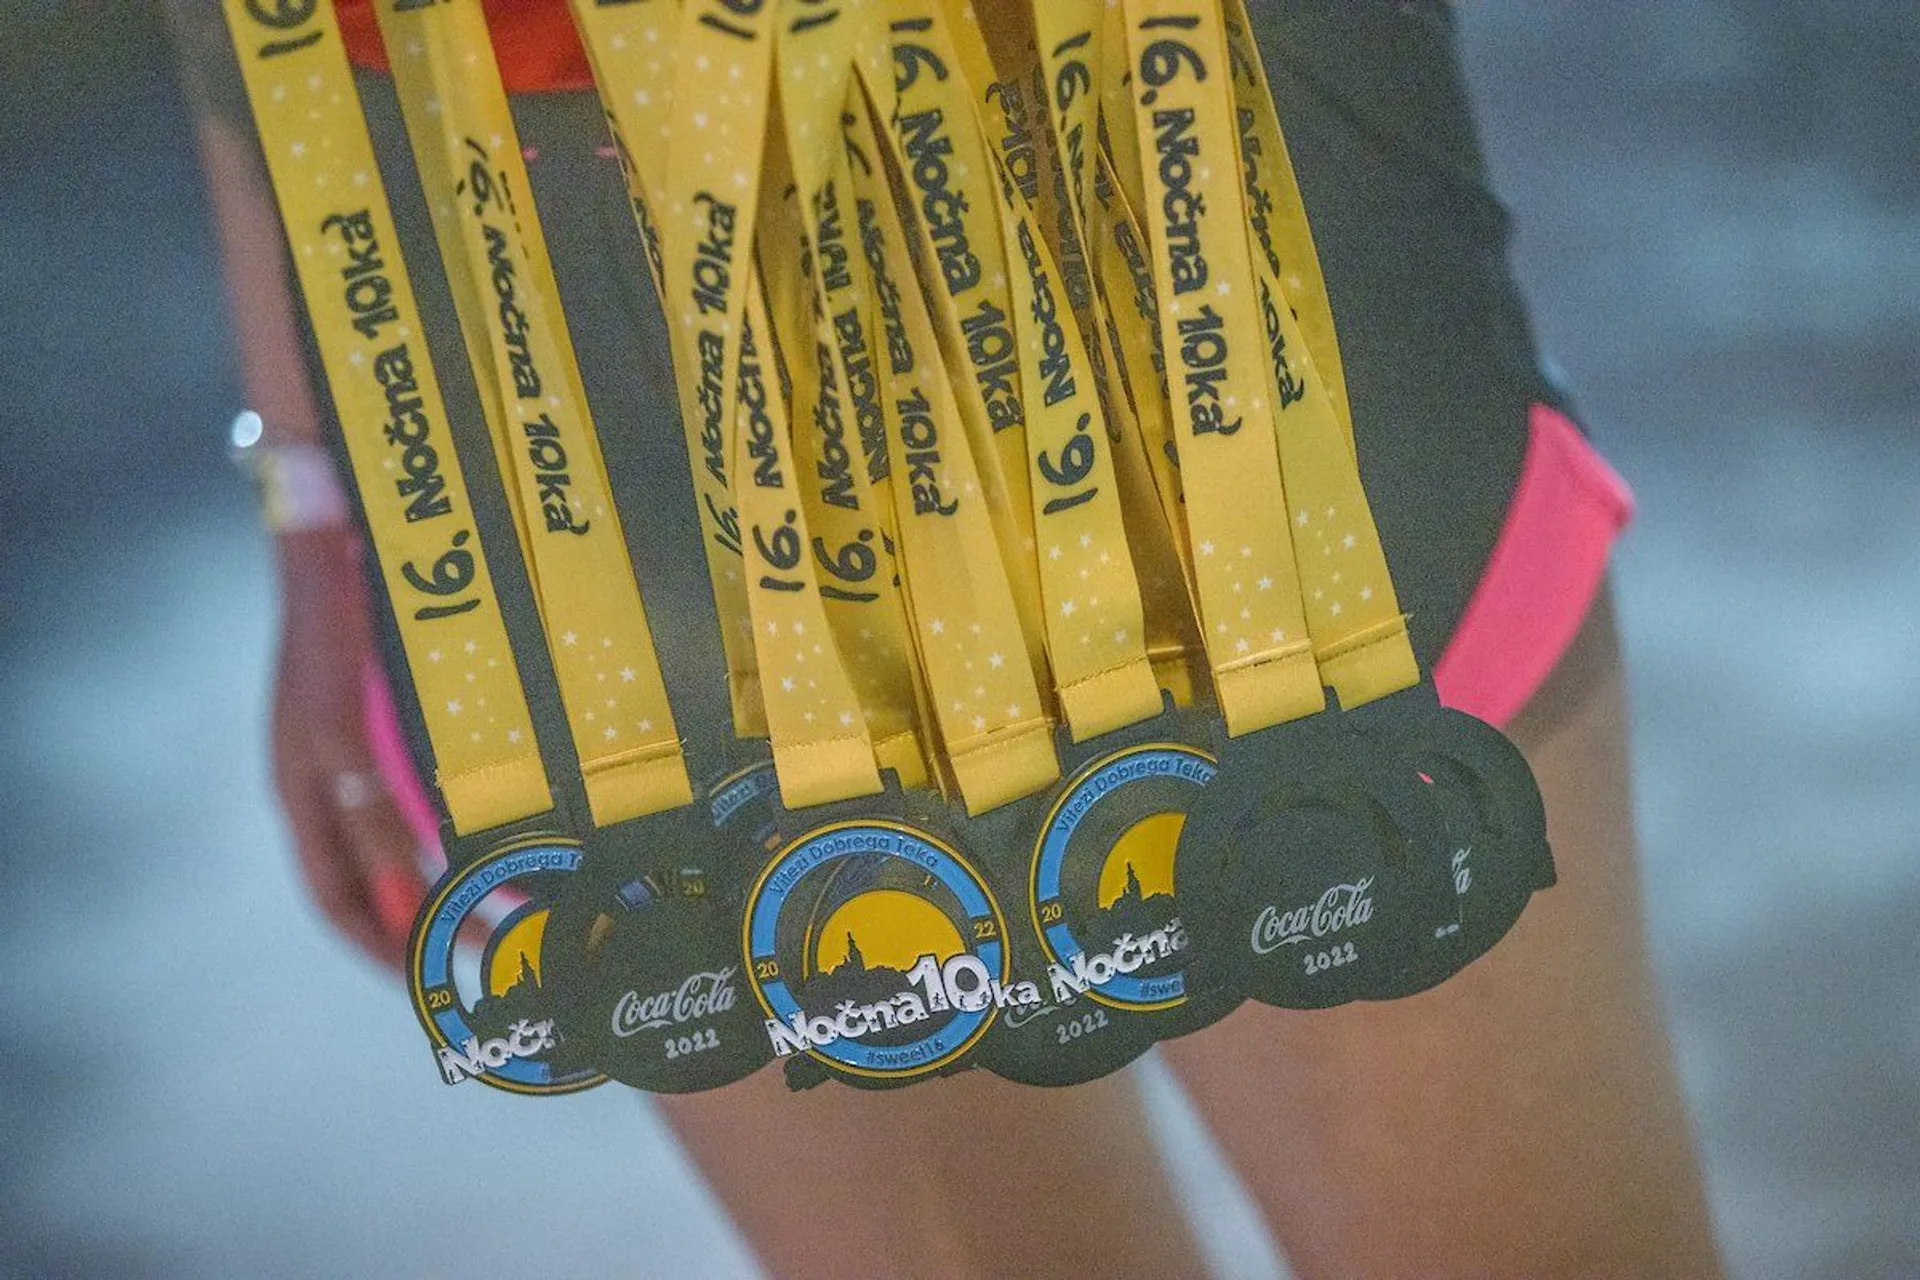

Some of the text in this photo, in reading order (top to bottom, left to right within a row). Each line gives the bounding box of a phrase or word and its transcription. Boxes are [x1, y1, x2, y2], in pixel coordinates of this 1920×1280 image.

[890, 18, 948, 97] 16
[898, 108, 981, 296] Nočna
[1140, 15, 1243, 437] 16. Nočna 10ka
[691, 189, 738, 315] 10ka
[1017, 218, 1077, 409] Nočna
[320, 207, 482, 622] 16. Nočna 10ka
[482, 224, 543, 400] Nočna
[523, 413, 591, 537] 10ka
[896, 386, 960, 517] 10ka
[1037, 411, 1099, 517] 16.
[752, 508, 806, 593] 16.
[811, 528, 881, 604] 16.
[1094, 759, 1170, 791] Dobrega
[808, 835, 890, 862] Dobrega
[973, 922, 996, 939] 22
[1041, 903, 1062, 923] 20
[429, 990, 451, 1009] 20
[757, 961, 780, 980] 20
[1303, 941, 1358, 985] 2022
[663, 1028, 721, 1060] 2022
[1056, 1008, 1109, 1045] 2022
